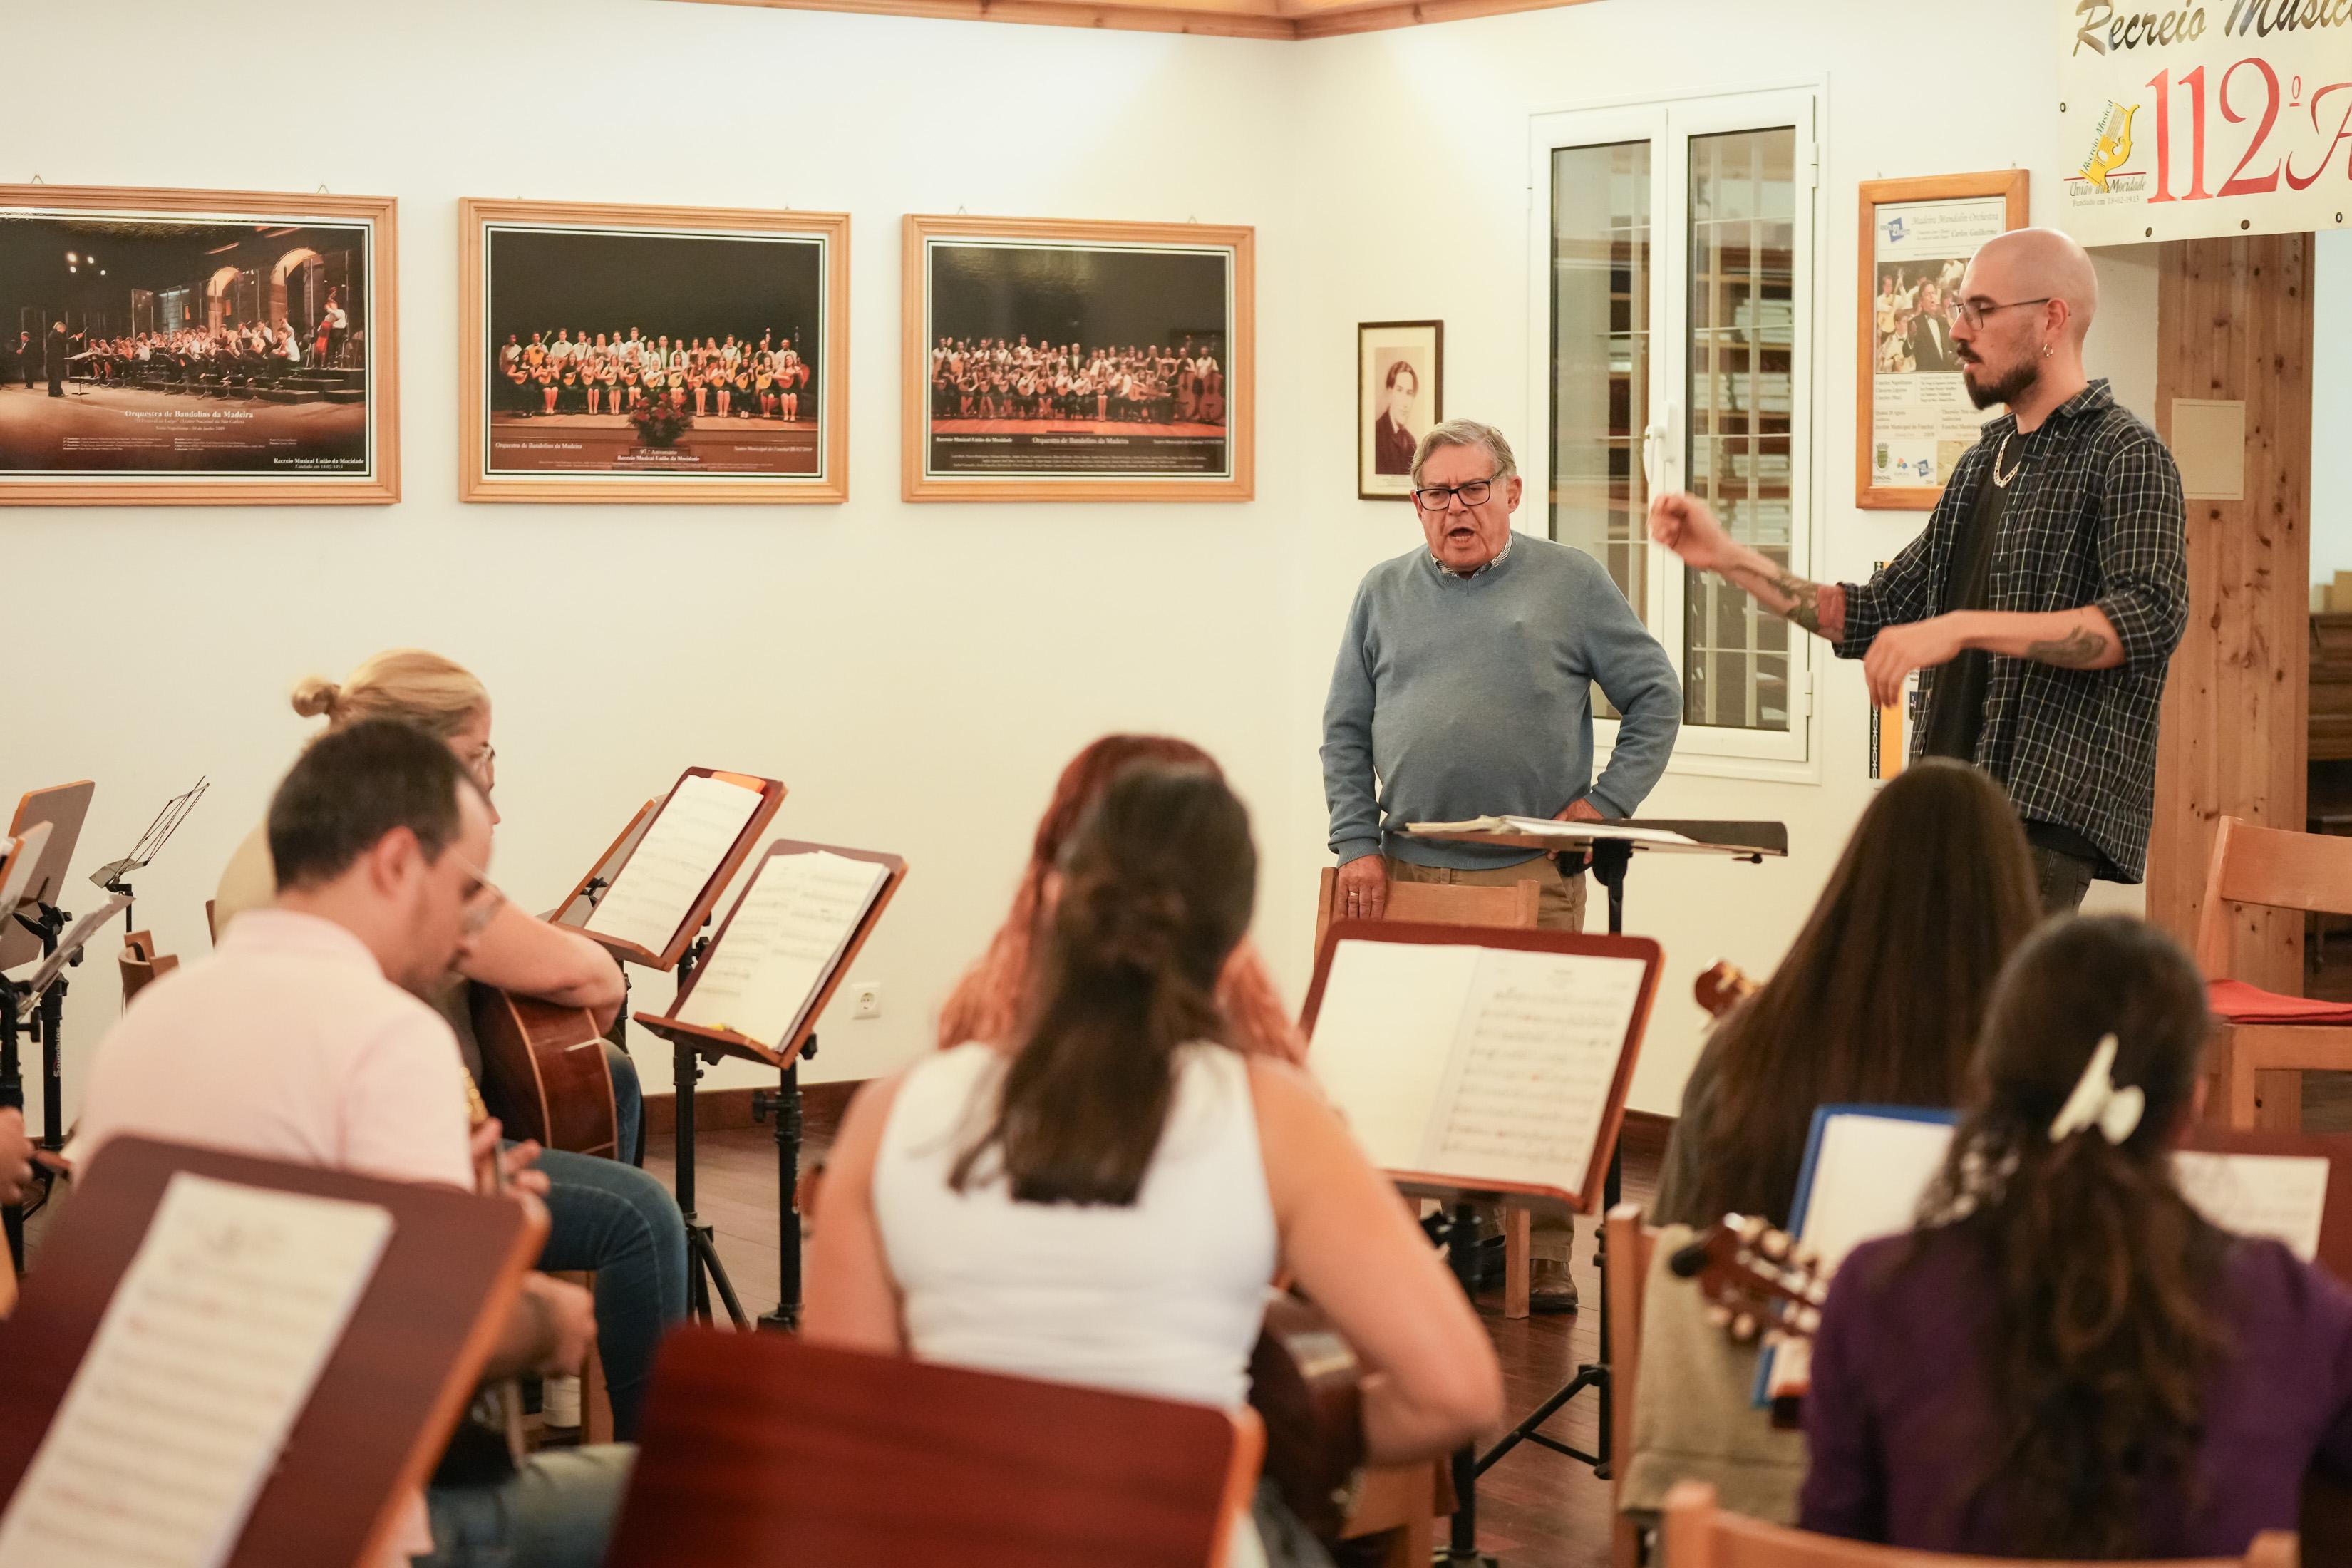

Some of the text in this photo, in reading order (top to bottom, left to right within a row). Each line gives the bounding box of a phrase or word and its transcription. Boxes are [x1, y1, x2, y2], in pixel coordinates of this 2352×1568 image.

[2073, 0, 2352, 57] Recreio Music
[2083, 99, 2114, 171] Recreio Musical
